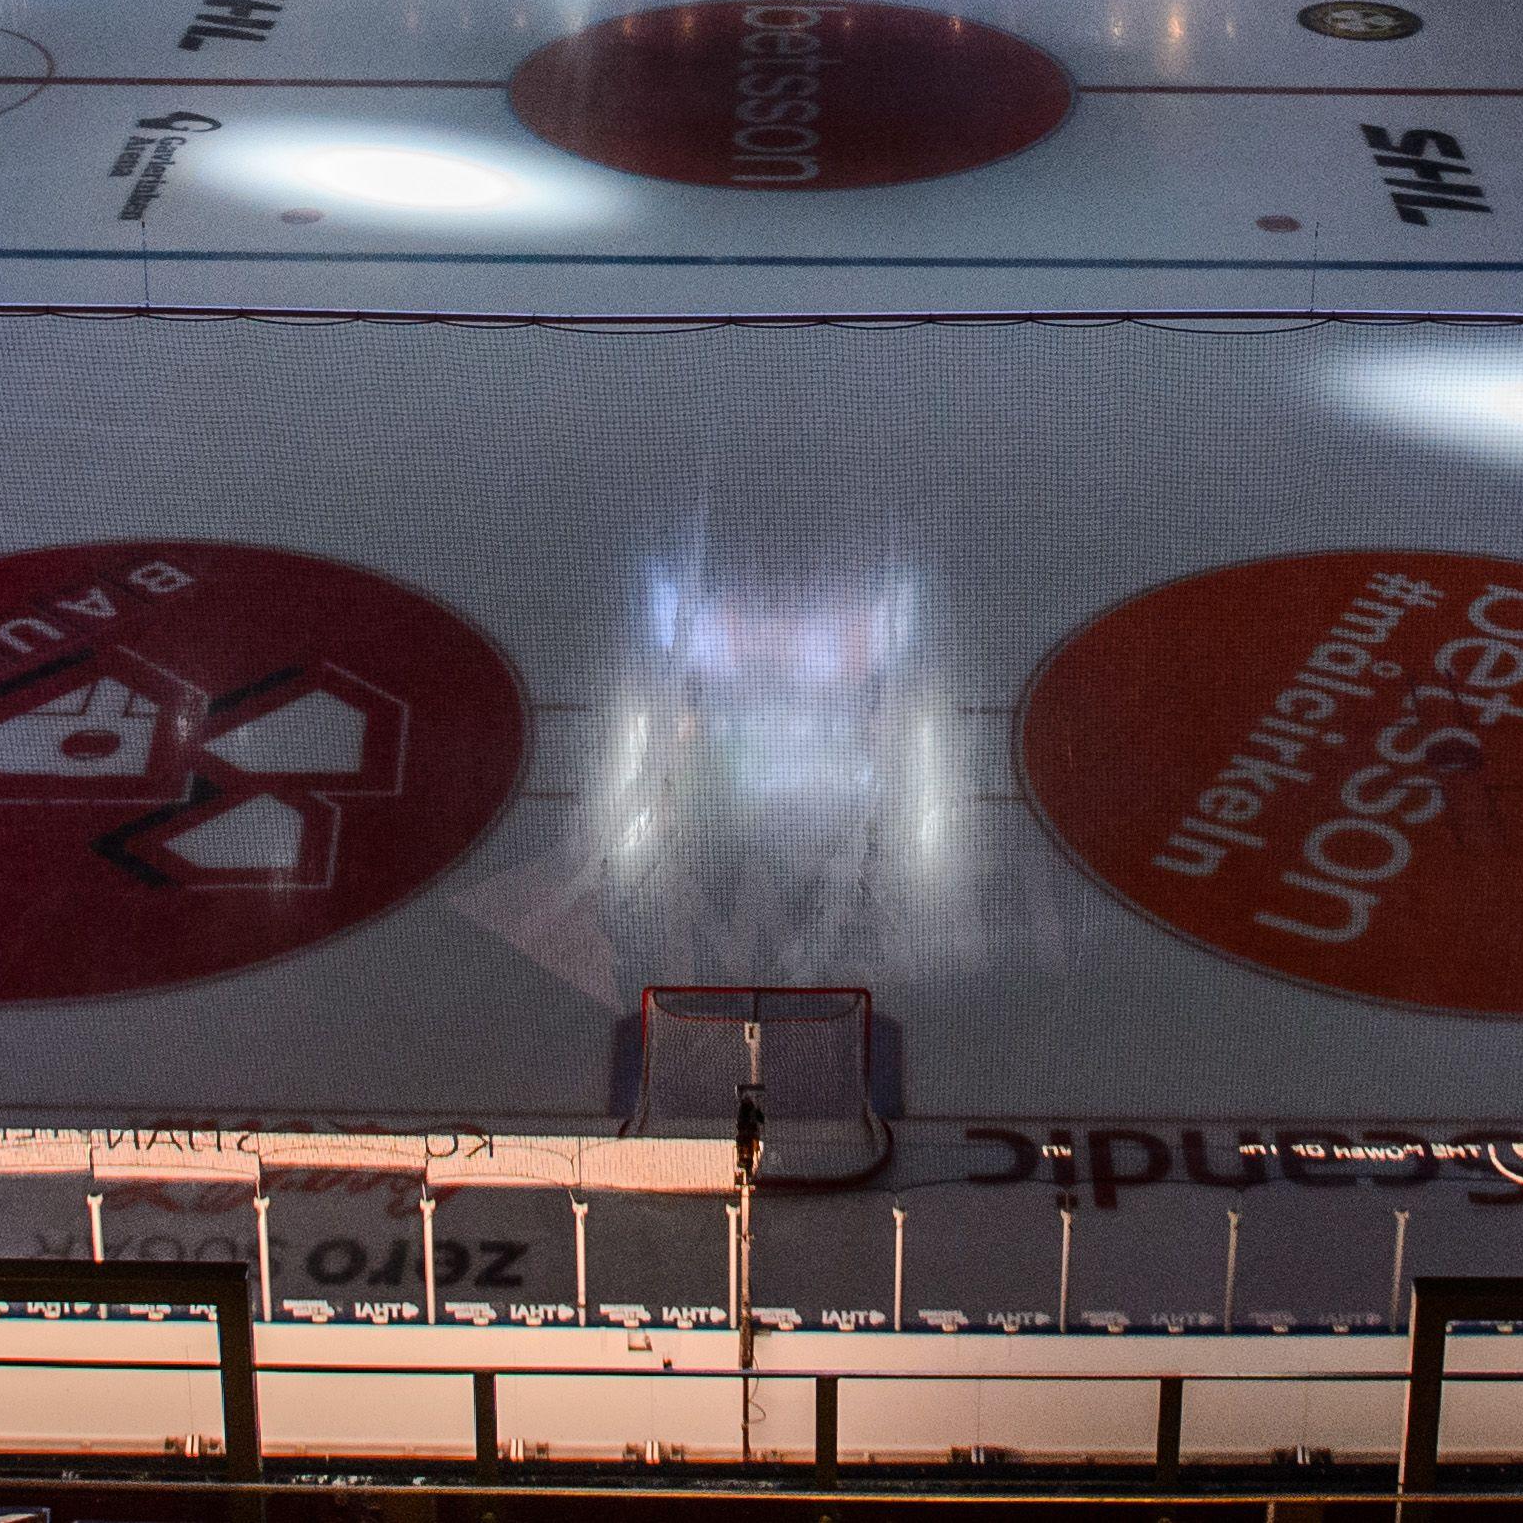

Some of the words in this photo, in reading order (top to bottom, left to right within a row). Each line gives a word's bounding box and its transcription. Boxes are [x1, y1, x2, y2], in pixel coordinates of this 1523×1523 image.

[730, 2, 822, 185] betsson
[108, 133, 158, 179] Arena
[118, 134, 188, 222] Gavlerinken
[1359, 121, 1493, 227] SHL
[1153, 570, 1445, 878] #målcirkeln
[304, 1237, 529, 1290] zero
